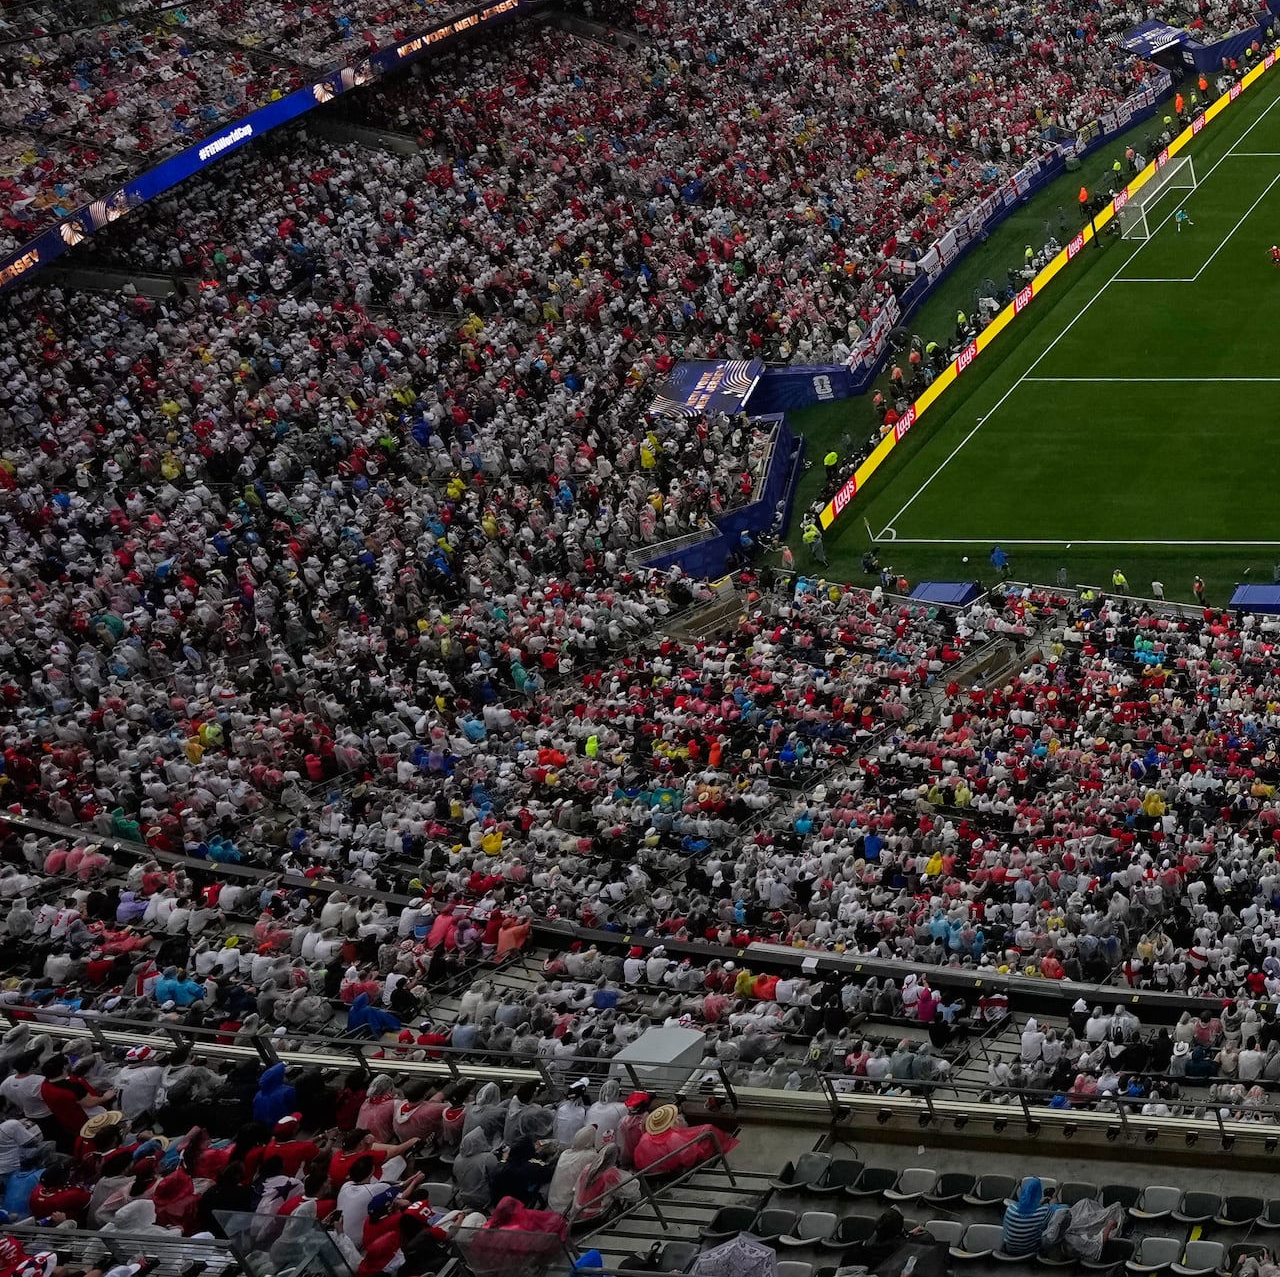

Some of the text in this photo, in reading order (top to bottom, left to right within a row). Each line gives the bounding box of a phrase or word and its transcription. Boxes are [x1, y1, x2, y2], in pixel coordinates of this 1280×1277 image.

[397, 38, 422, 58] NEW
[422, 26, 455, 47] YORK
[454, 13, 479, 32] NEW
[1230, 82, 1242, 100] Lay's
[1193, 114, 1205, 135] Lay's
[199, 124, 253, 161] #FIFAWorldCup
[1114, 188, 1129, 211] Lay's
[1068, 233, 1084, 260] Lay's
[1015, 285, 1033, 313] Lay's
[957, 341, 977, 373] Lay's
[895, 407, 916, 441] Lay's
[833, 479, 855, 515] Lay's
